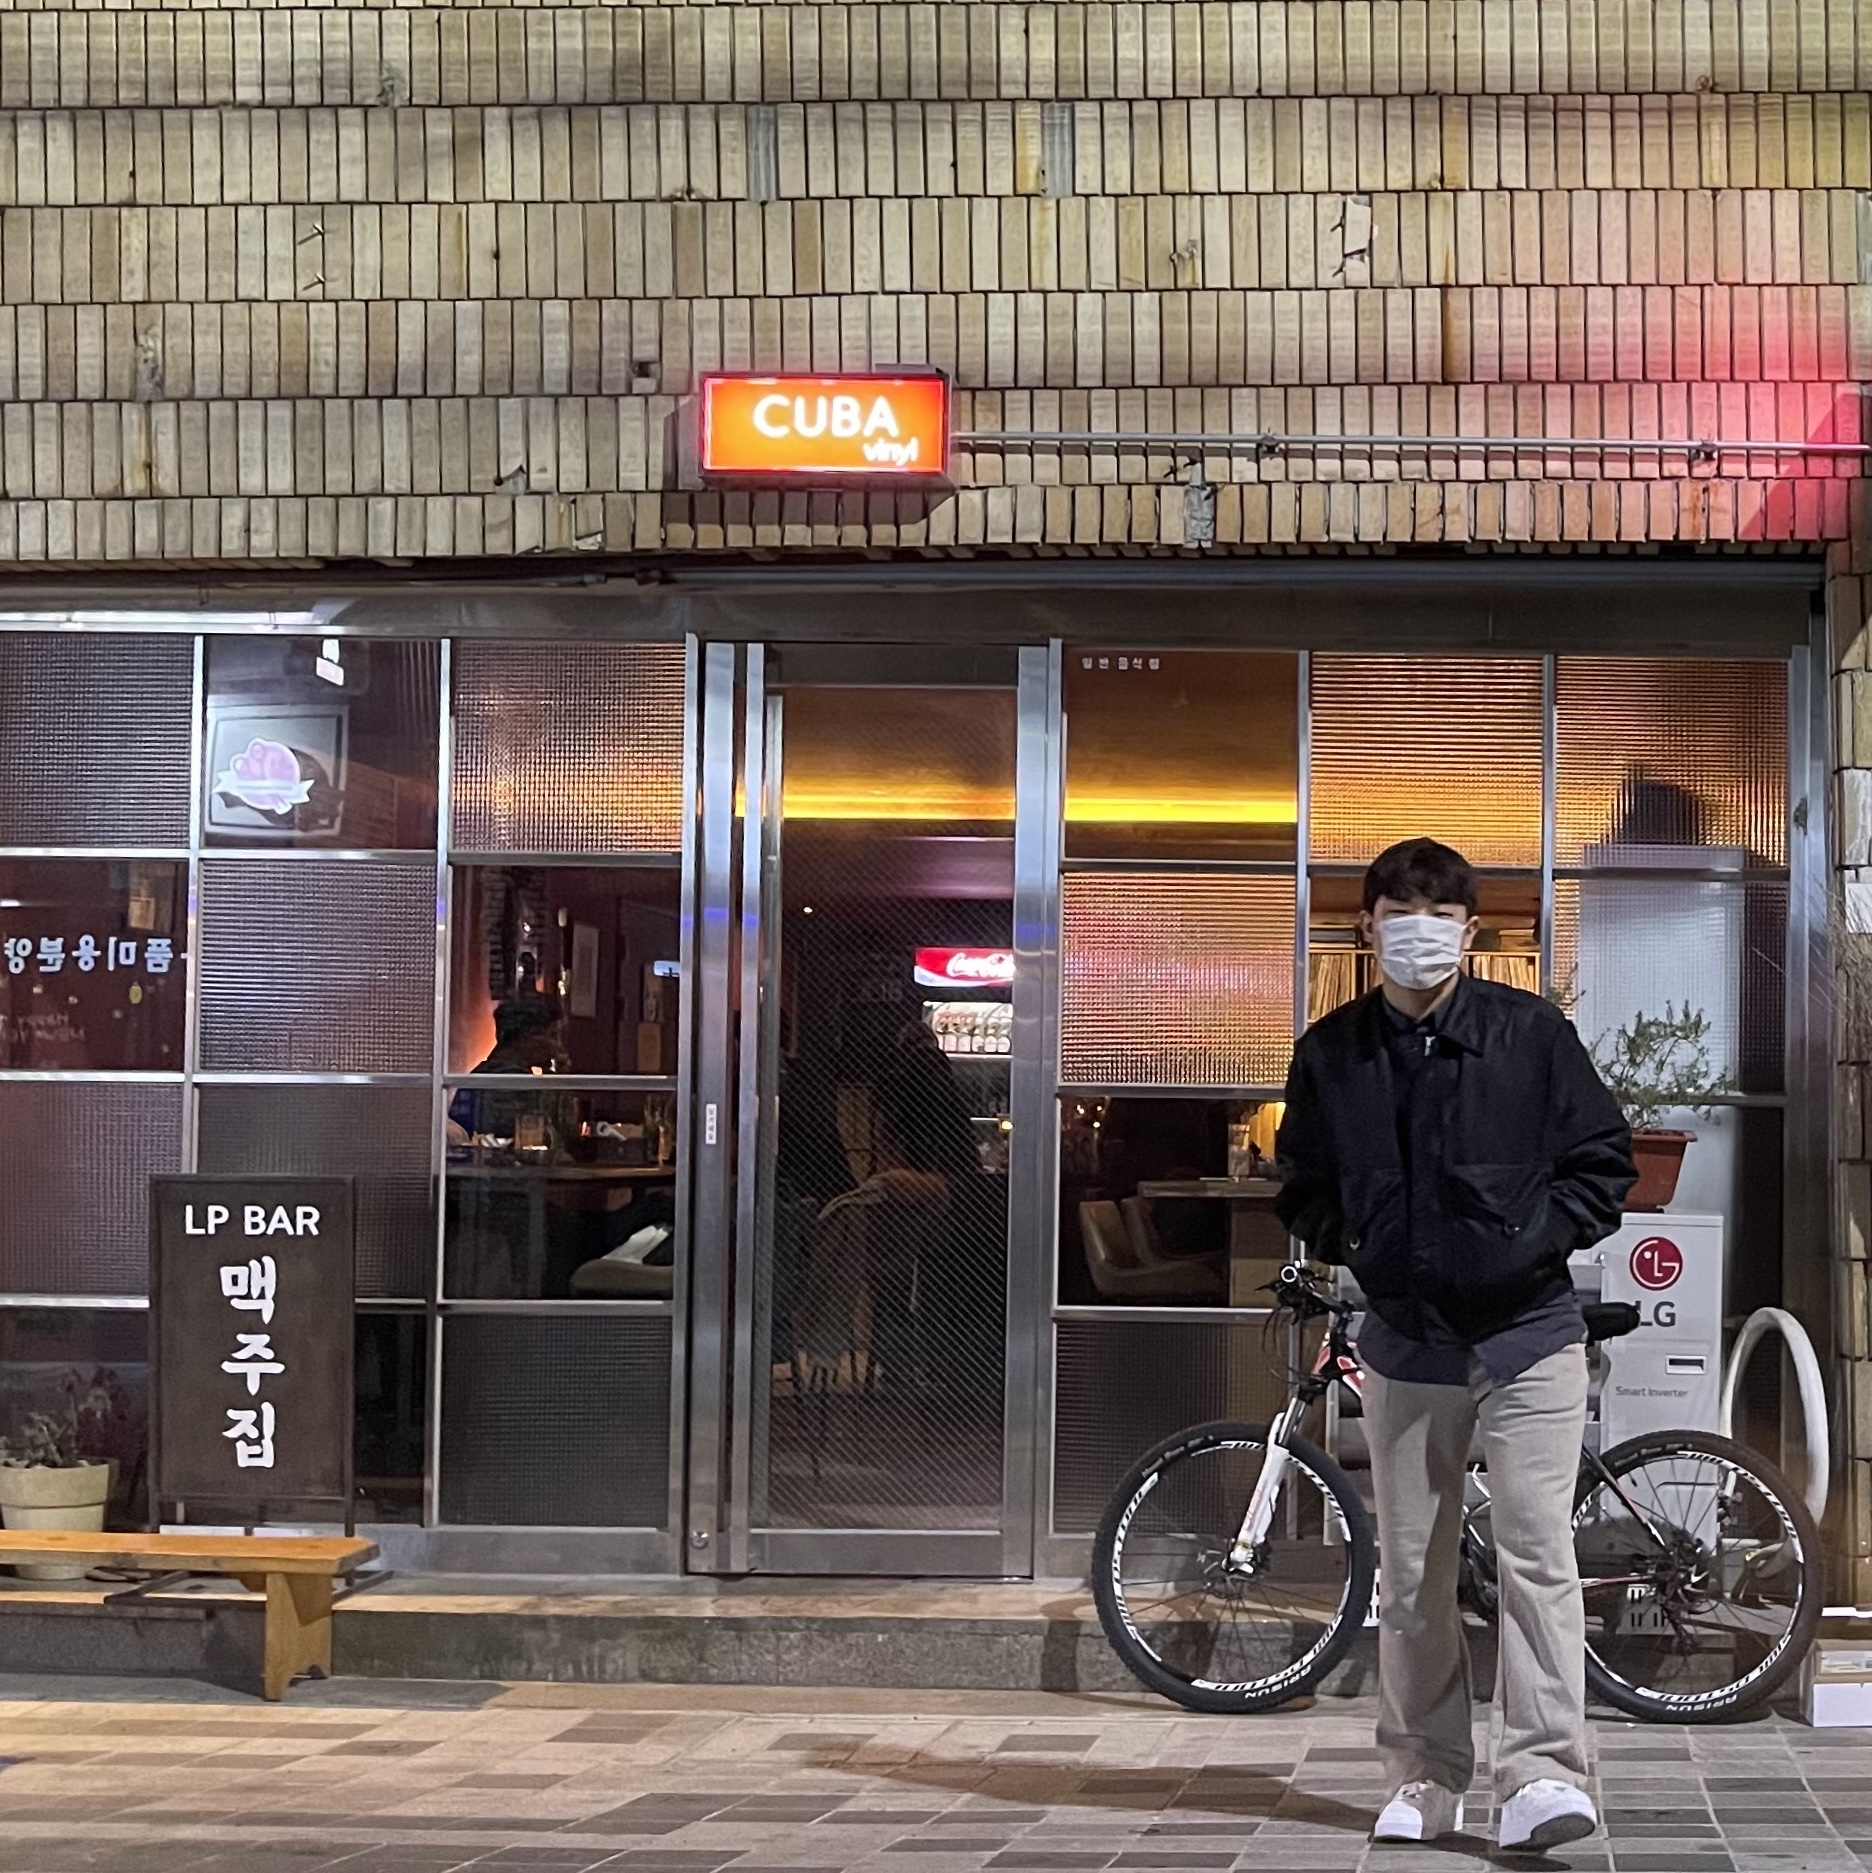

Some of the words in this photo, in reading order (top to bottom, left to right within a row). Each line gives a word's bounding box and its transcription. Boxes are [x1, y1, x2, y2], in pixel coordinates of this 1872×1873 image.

[753, 394, 899, 438] CUBA
[862, 437, 919, 466] vinyl
[185, 1205, 229, 1235] LP
[244, 1205, 320, 1236] BAR
[219, 1255, 286, 1468] 맥주집
[1616, 1386, 1647, 1397] Smart
[1648, 1387, 1689, 1398] Inverter
